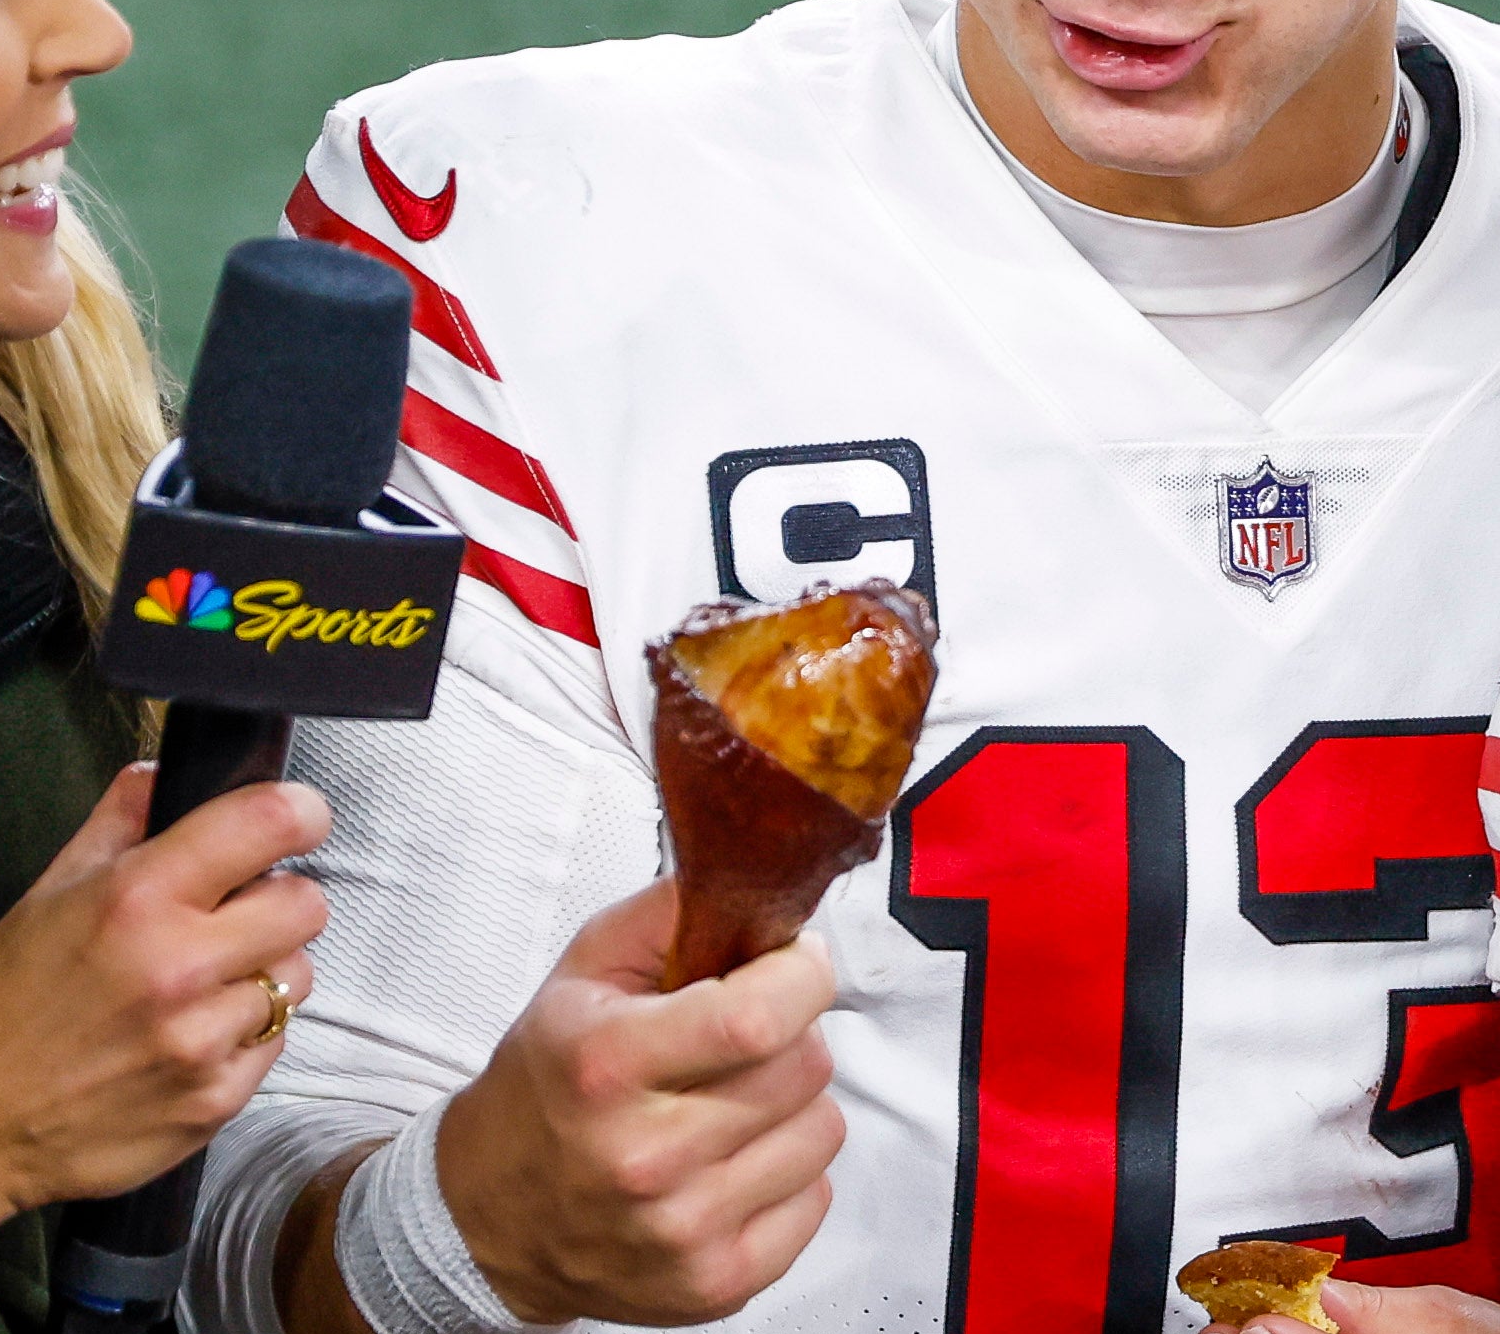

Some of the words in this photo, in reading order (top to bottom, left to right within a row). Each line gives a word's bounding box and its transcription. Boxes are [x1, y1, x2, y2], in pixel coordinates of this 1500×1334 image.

[727, 457, 916, 604] C
[1237, 522, 1304, 573] NFL
[233, 579, 436, 655] Sports
